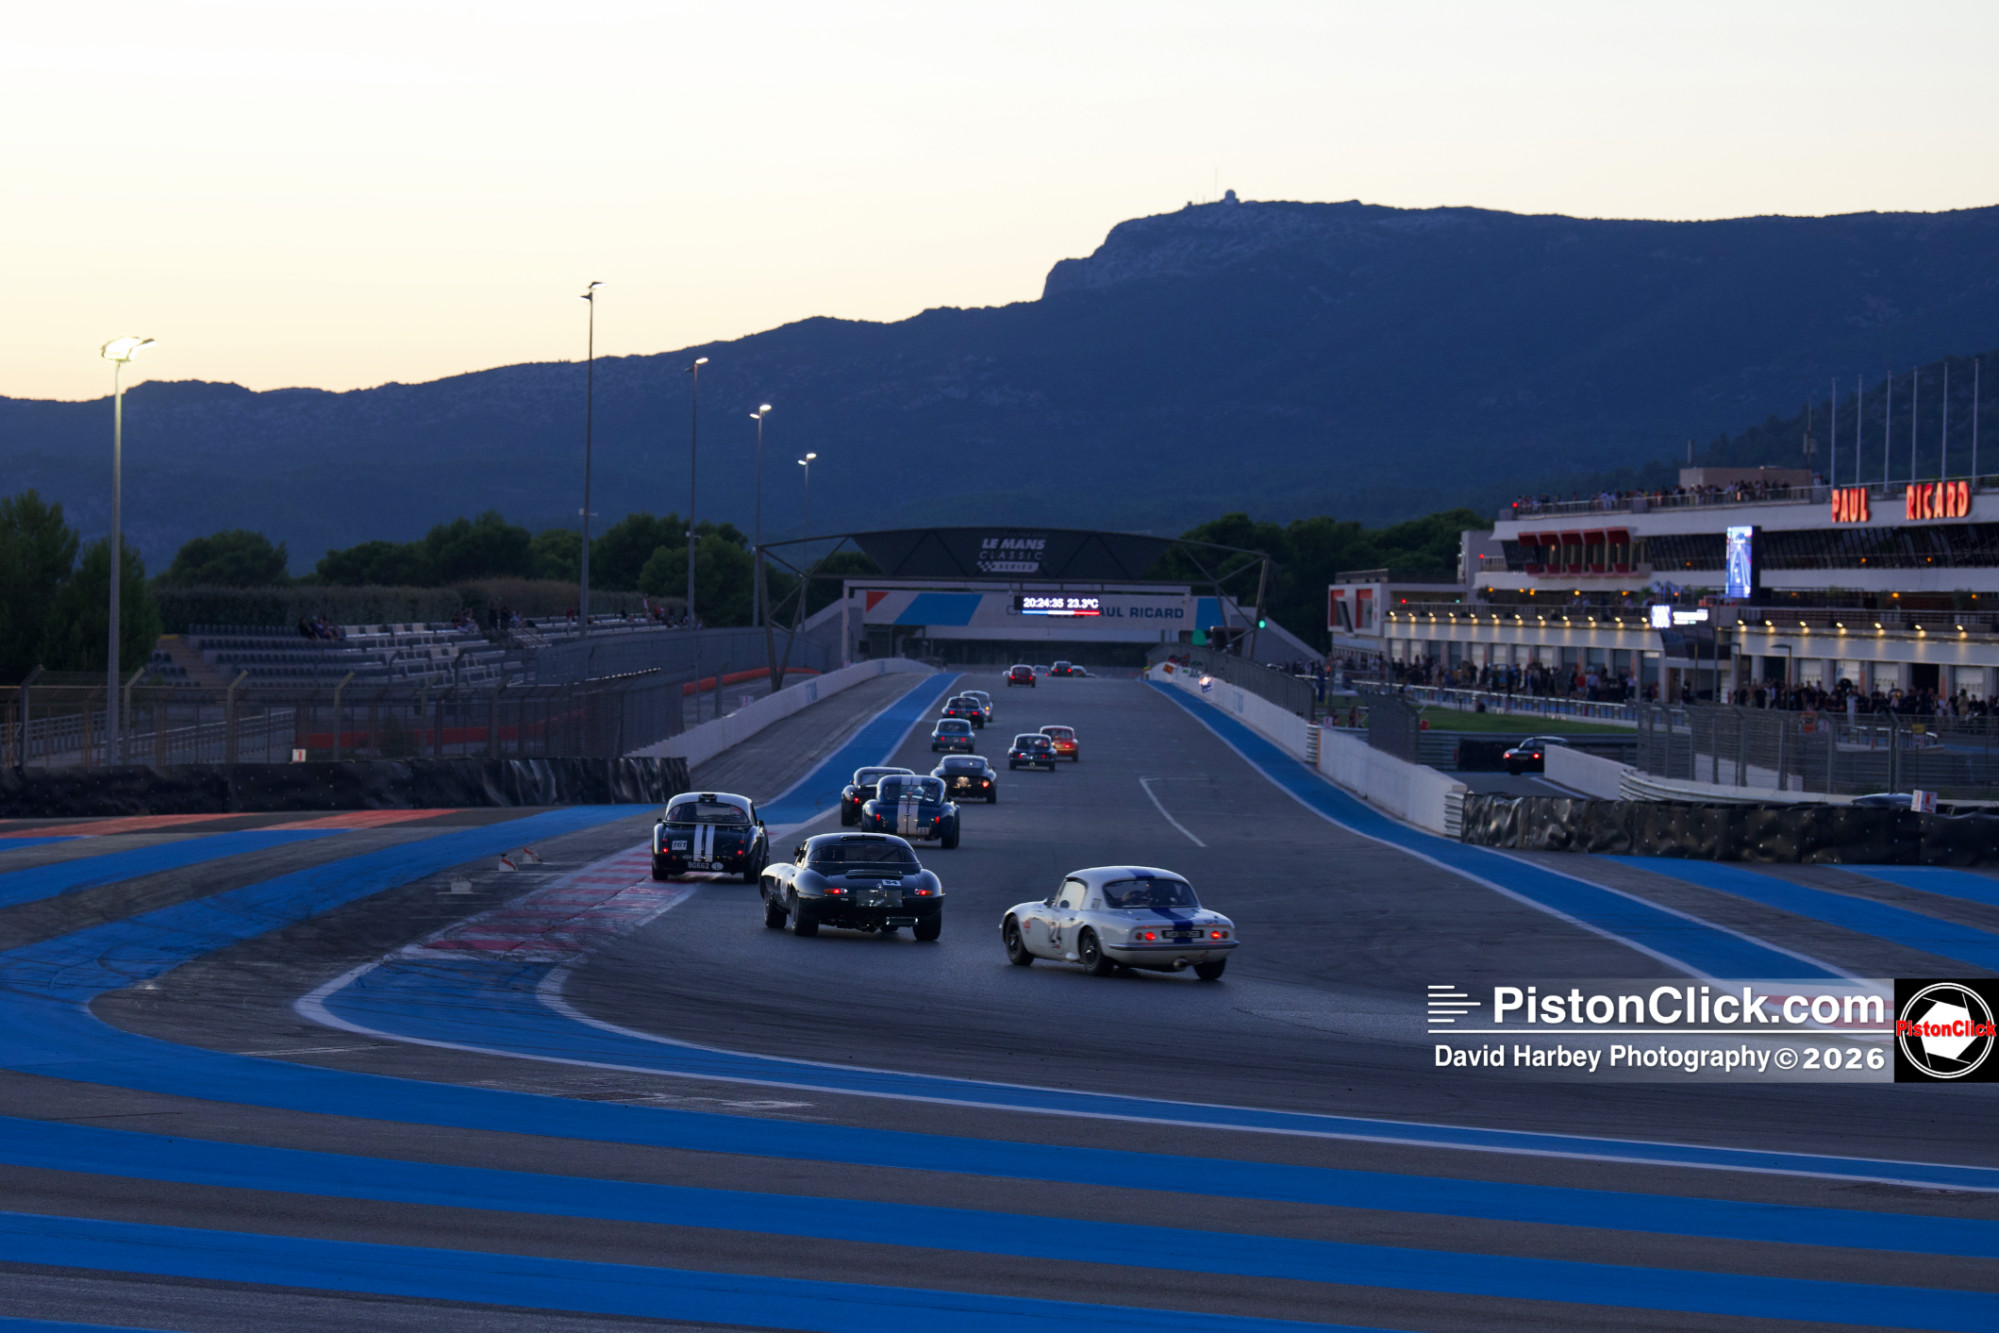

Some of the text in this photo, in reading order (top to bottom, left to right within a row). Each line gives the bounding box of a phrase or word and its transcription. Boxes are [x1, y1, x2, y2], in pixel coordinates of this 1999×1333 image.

[1832, 481, 1970, 523] PAUL RICARD
[982, 538, 1046, 550] LE MANS
[979, 551, 1043, 560] CLASSIC
[1023, 597, 1064, 608] 20:24:35
[1098, 606, 1184, 619] AUL RICARD
